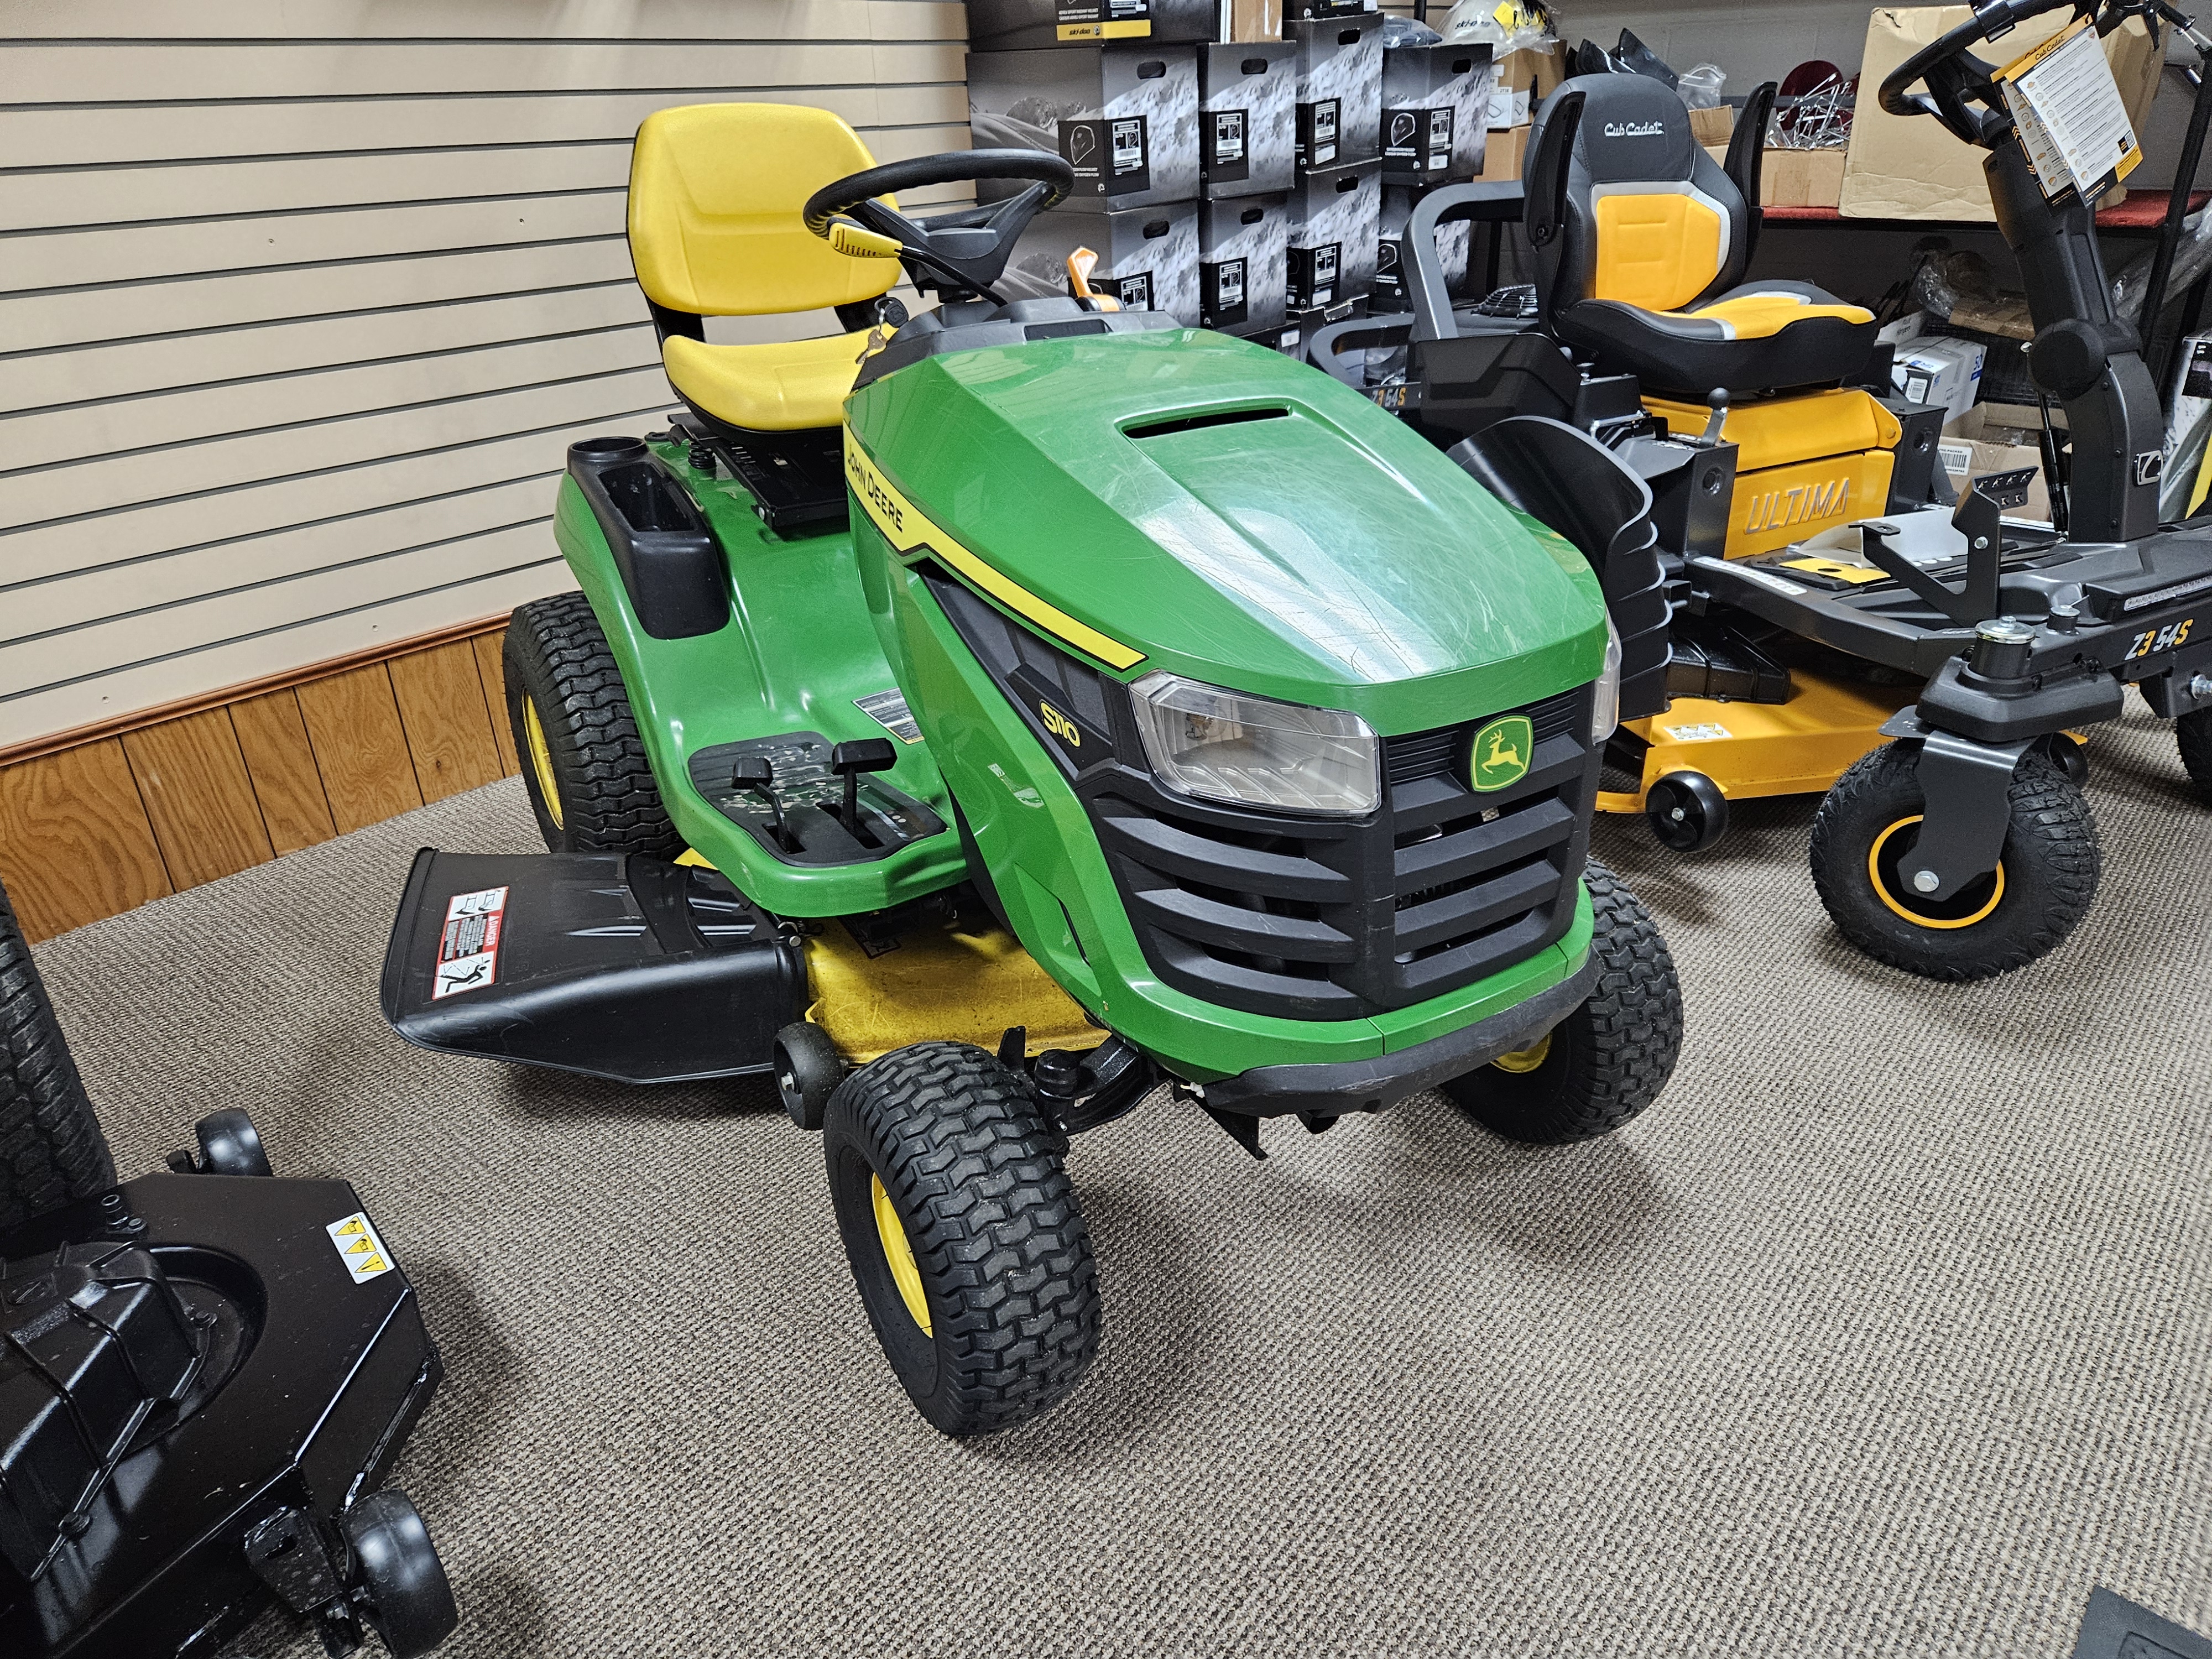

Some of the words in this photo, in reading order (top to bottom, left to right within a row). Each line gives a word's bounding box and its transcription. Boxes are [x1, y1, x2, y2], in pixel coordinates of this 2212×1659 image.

[2035, 49, 2047, 60] Cub
[2047, 35, 2065, 51] Cadet
[1604, 122, 1625, 137] Cub
[1626, 121, 1664, 136] Cadet
[848, 444, 866, 490] JOHN
[868, 471, 903, 533] DEERE
[1744, 477, 1849, 535] ULTIMA
[1040, 702, 1081, 747] S110
[485, 920, 499, 947] DANGER
